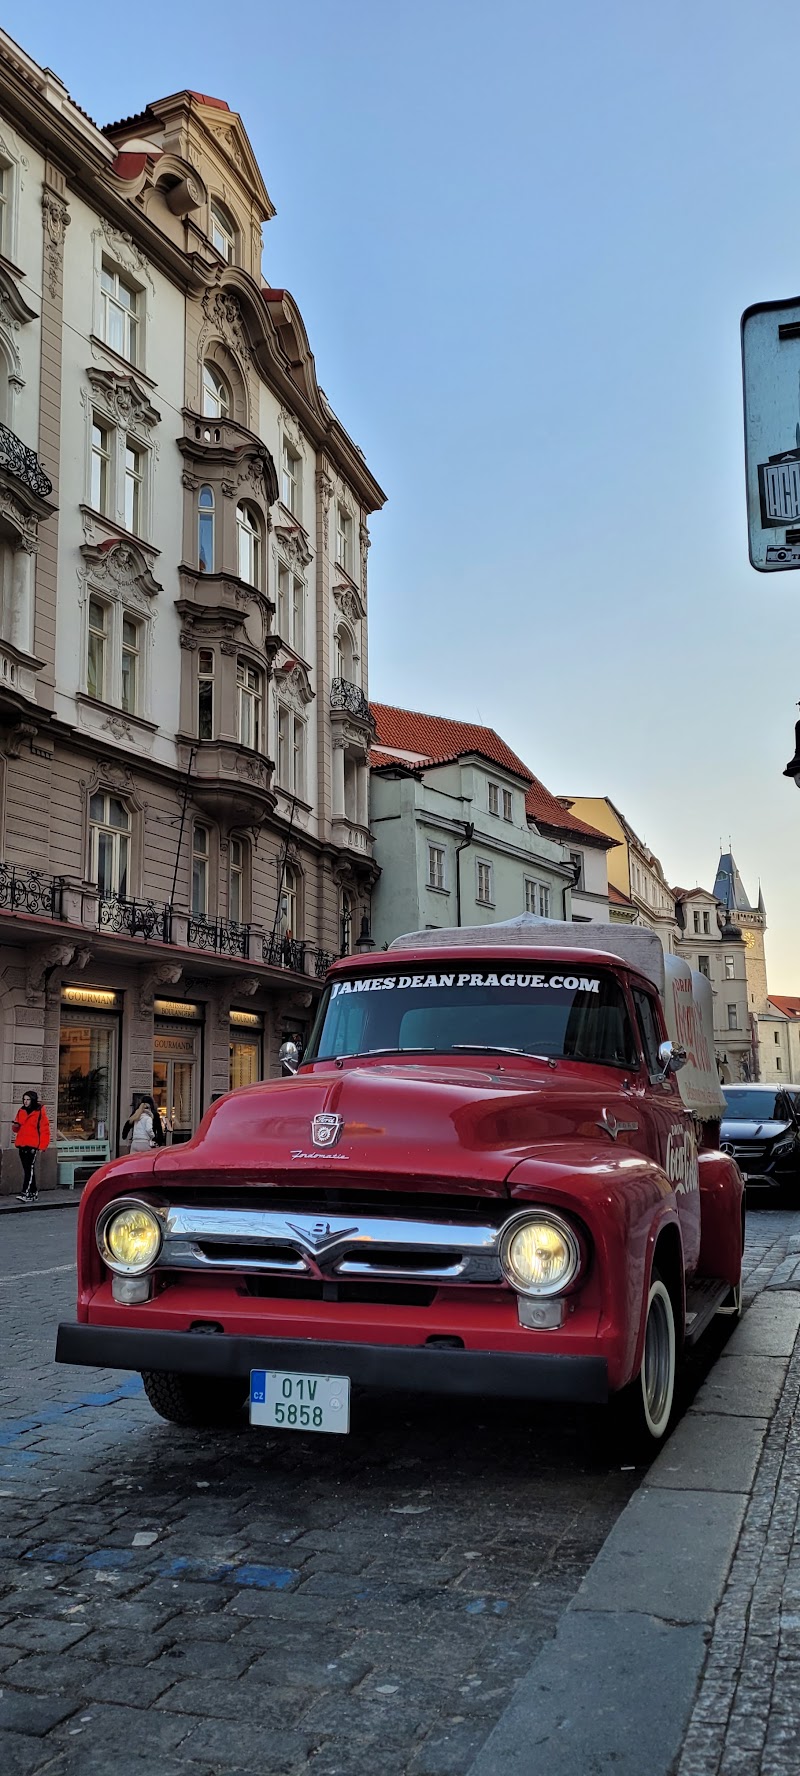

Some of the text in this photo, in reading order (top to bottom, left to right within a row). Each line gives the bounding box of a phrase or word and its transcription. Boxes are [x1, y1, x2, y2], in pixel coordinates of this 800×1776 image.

[330, 973, 600, 1000] JAMES DEAN PRAGUE.COM
[154, 1039, 191, 1050] GOURMAND
[253, 1391, 264, 1400] CZ
[282, 1378, 318, 1401] 01V
[274, 1402, 323, 1427] 5858
